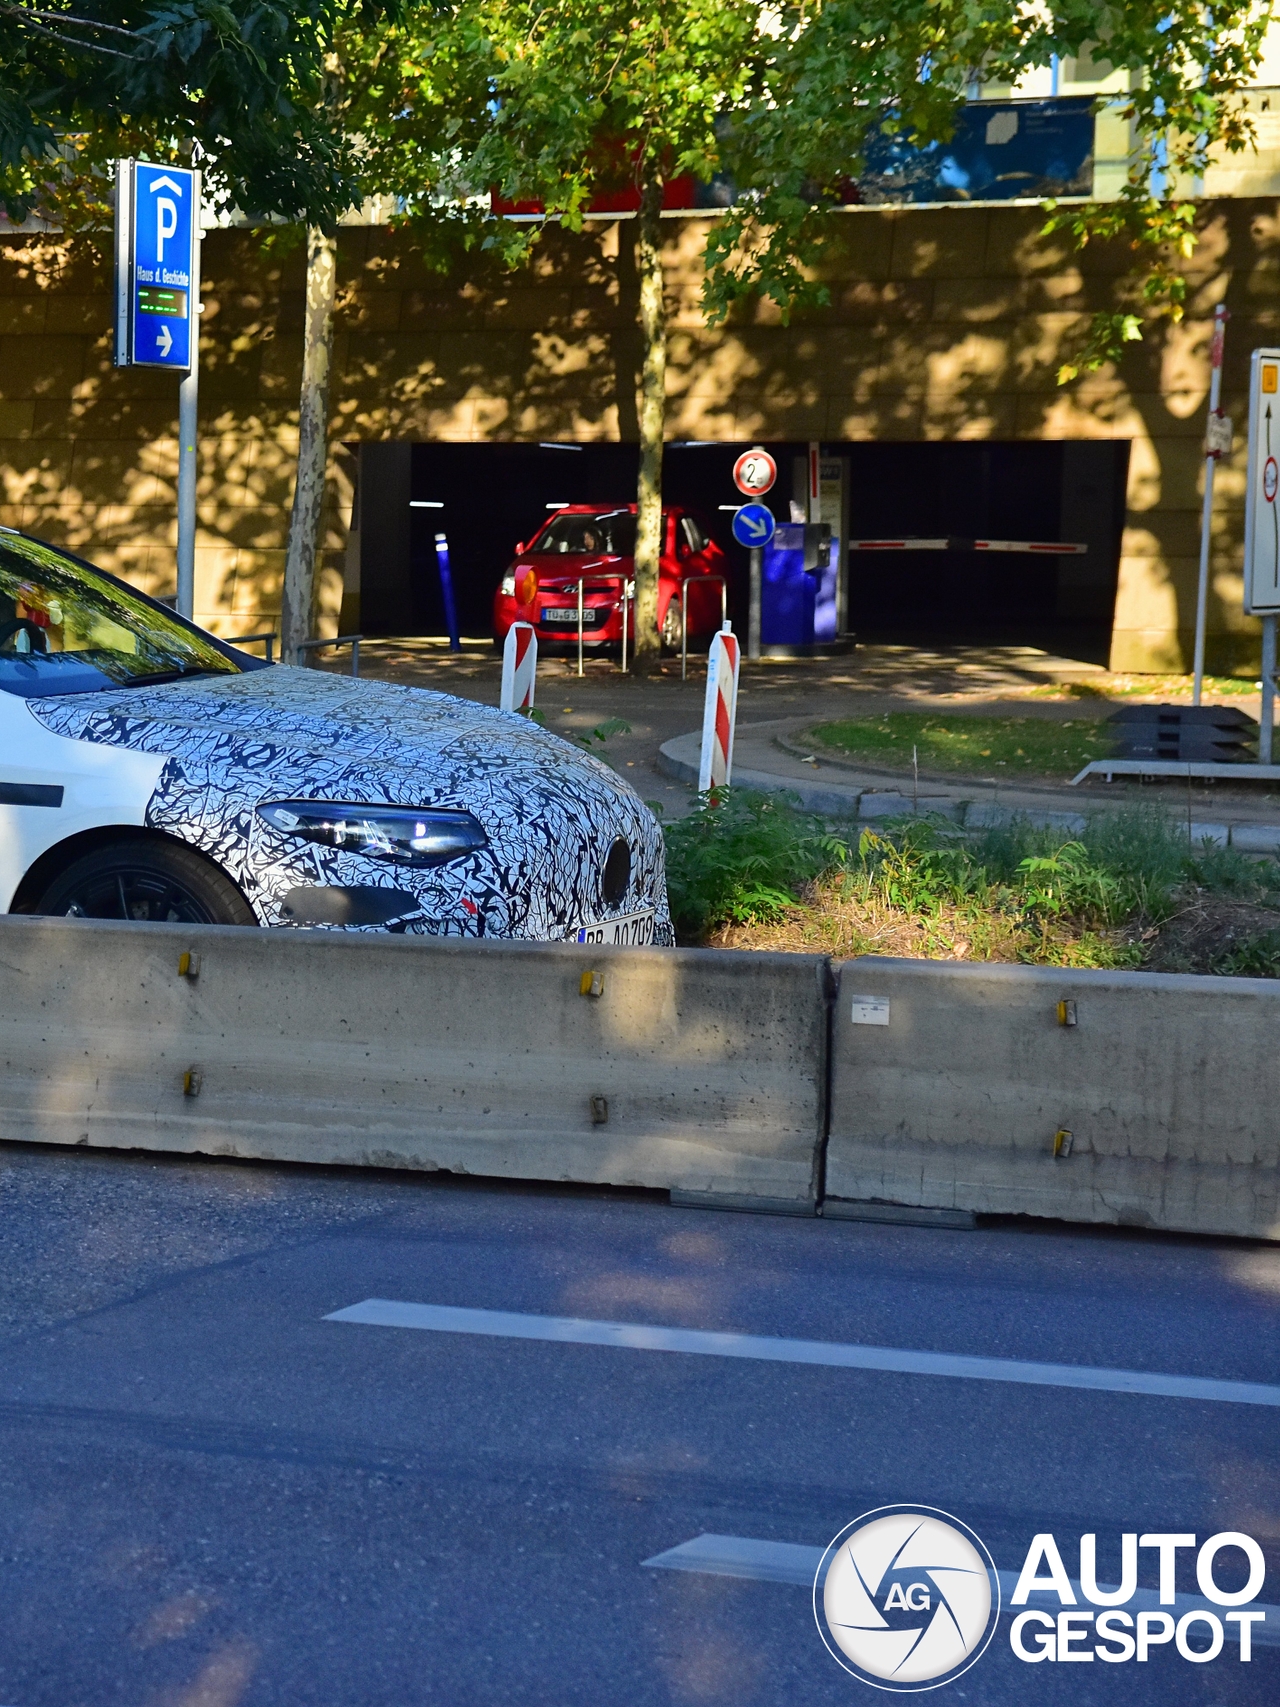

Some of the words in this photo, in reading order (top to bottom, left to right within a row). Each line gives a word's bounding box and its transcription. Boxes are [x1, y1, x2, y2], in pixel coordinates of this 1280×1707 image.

[156, 196, 178, 262] P
[136, 265, 154, 283] Haus
[155, 267, 162, 283] d.
[162, 267, 189, 287] Geschichte
